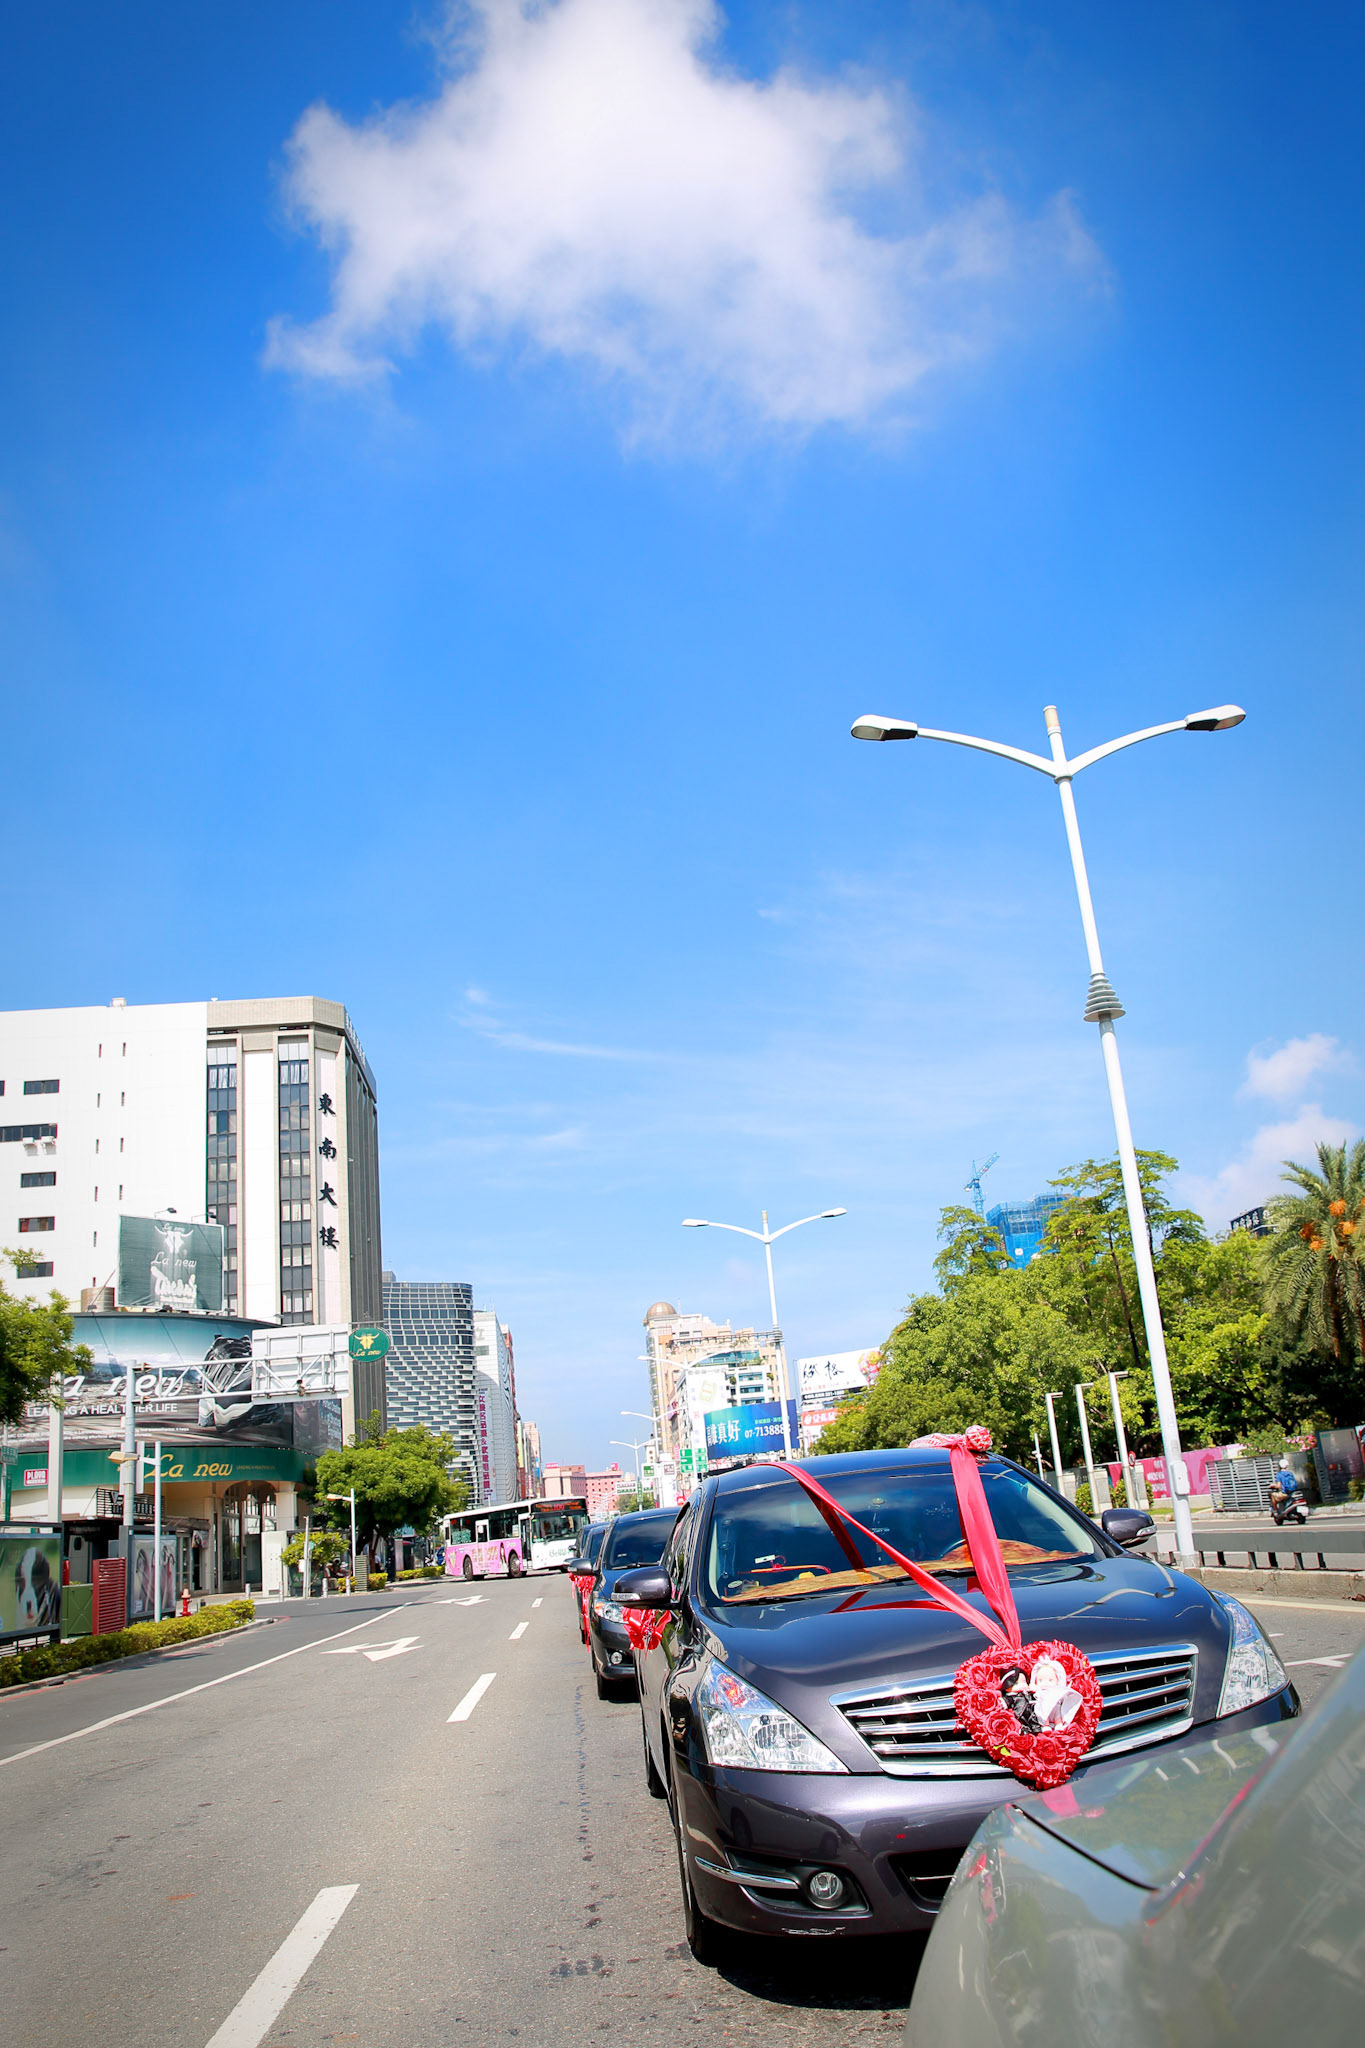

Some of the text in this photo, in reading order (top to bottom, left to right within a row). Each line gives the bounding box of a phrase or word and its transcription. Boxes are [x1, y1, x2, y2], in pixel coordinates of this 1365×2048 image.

[318, 1093, 339, 1249] 東南大樓
[151, 1252, 196, 1268] La new
[103, 1374, 183, 1397] new
[27, 1403, 178, 1417] LEANG A HEALTIER LIFE
[144, 1454, 233, 1478] La new
